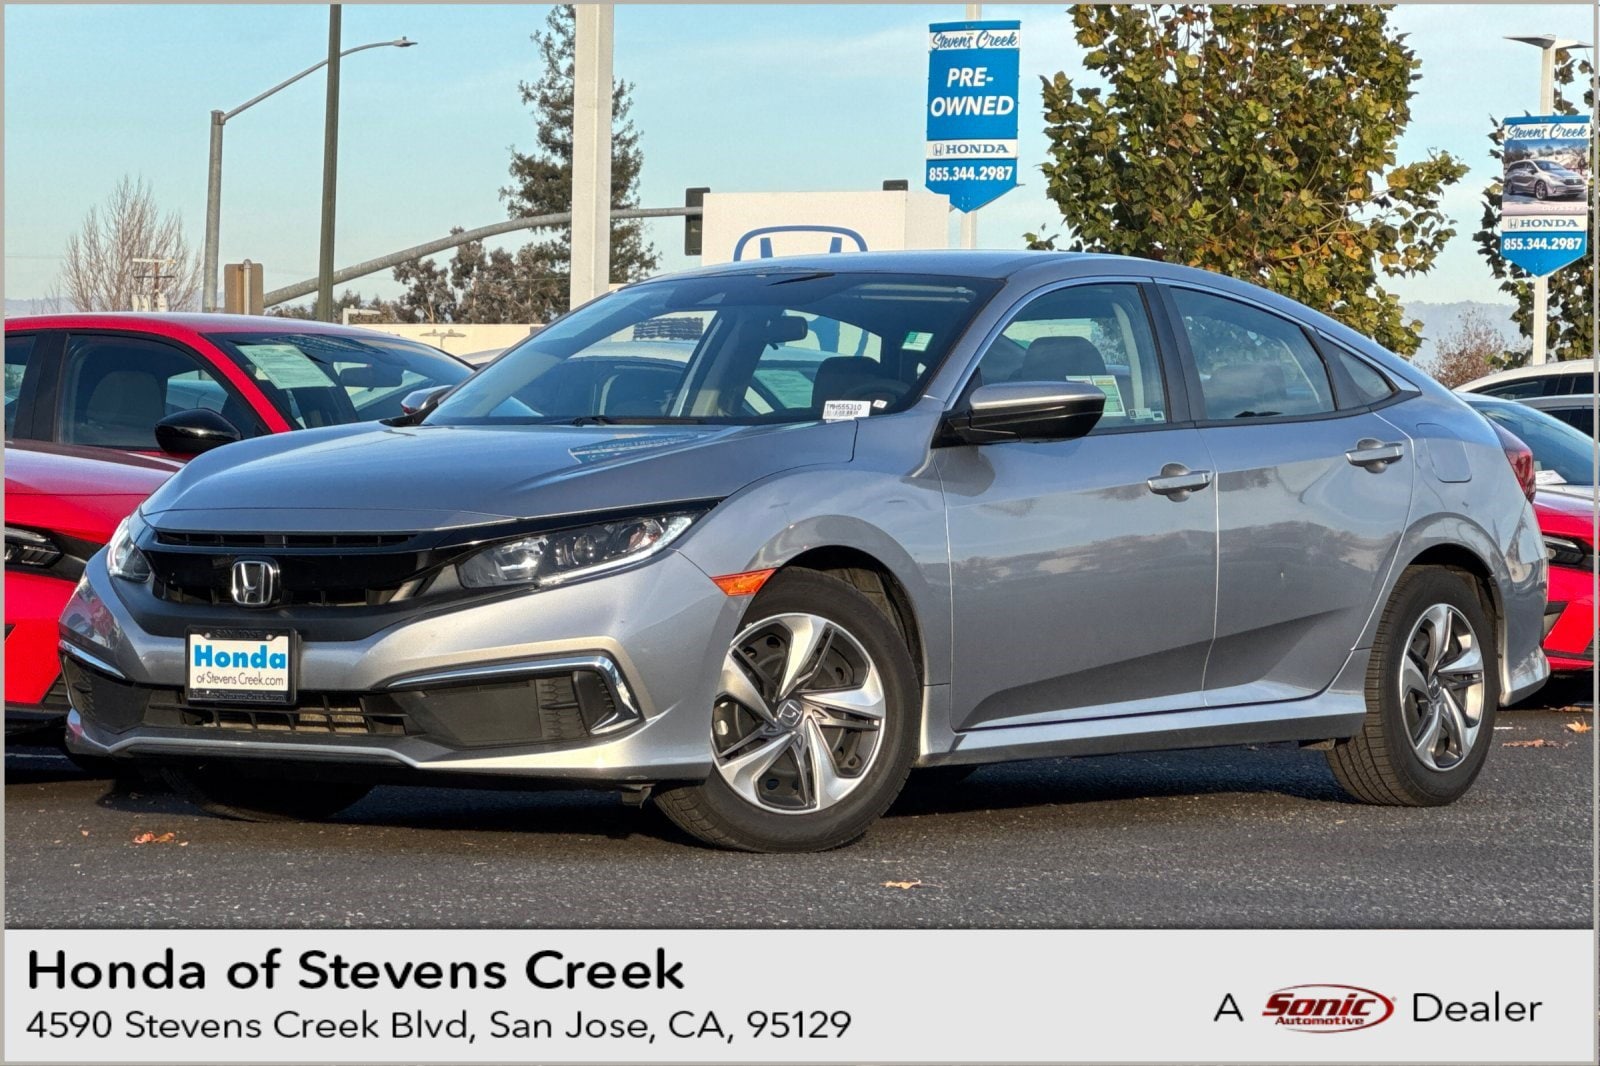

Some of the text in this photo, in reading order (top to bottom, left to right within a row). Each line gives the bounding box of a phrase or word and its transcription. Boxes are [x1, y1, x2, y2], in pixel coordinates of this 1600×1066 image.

[932, 30, 1018, 51] Stevens Creek
[947, 67, 993, 87] PRE-
[930, 95, 1014, 117] OWNED
[1507, 123, 1587, 141] Stevens Creek
[945, 144, 1009, 154] HONDA
[929, 166, 1013, 181] 855.344.2987
[1520, 219, 1579, 228] HONDA
[1504, 237, 1582, 250] 855.344.2987
[194, 645, 286, 669] Honda
[196, 671, 284, 686] of Stevens Creek.com
